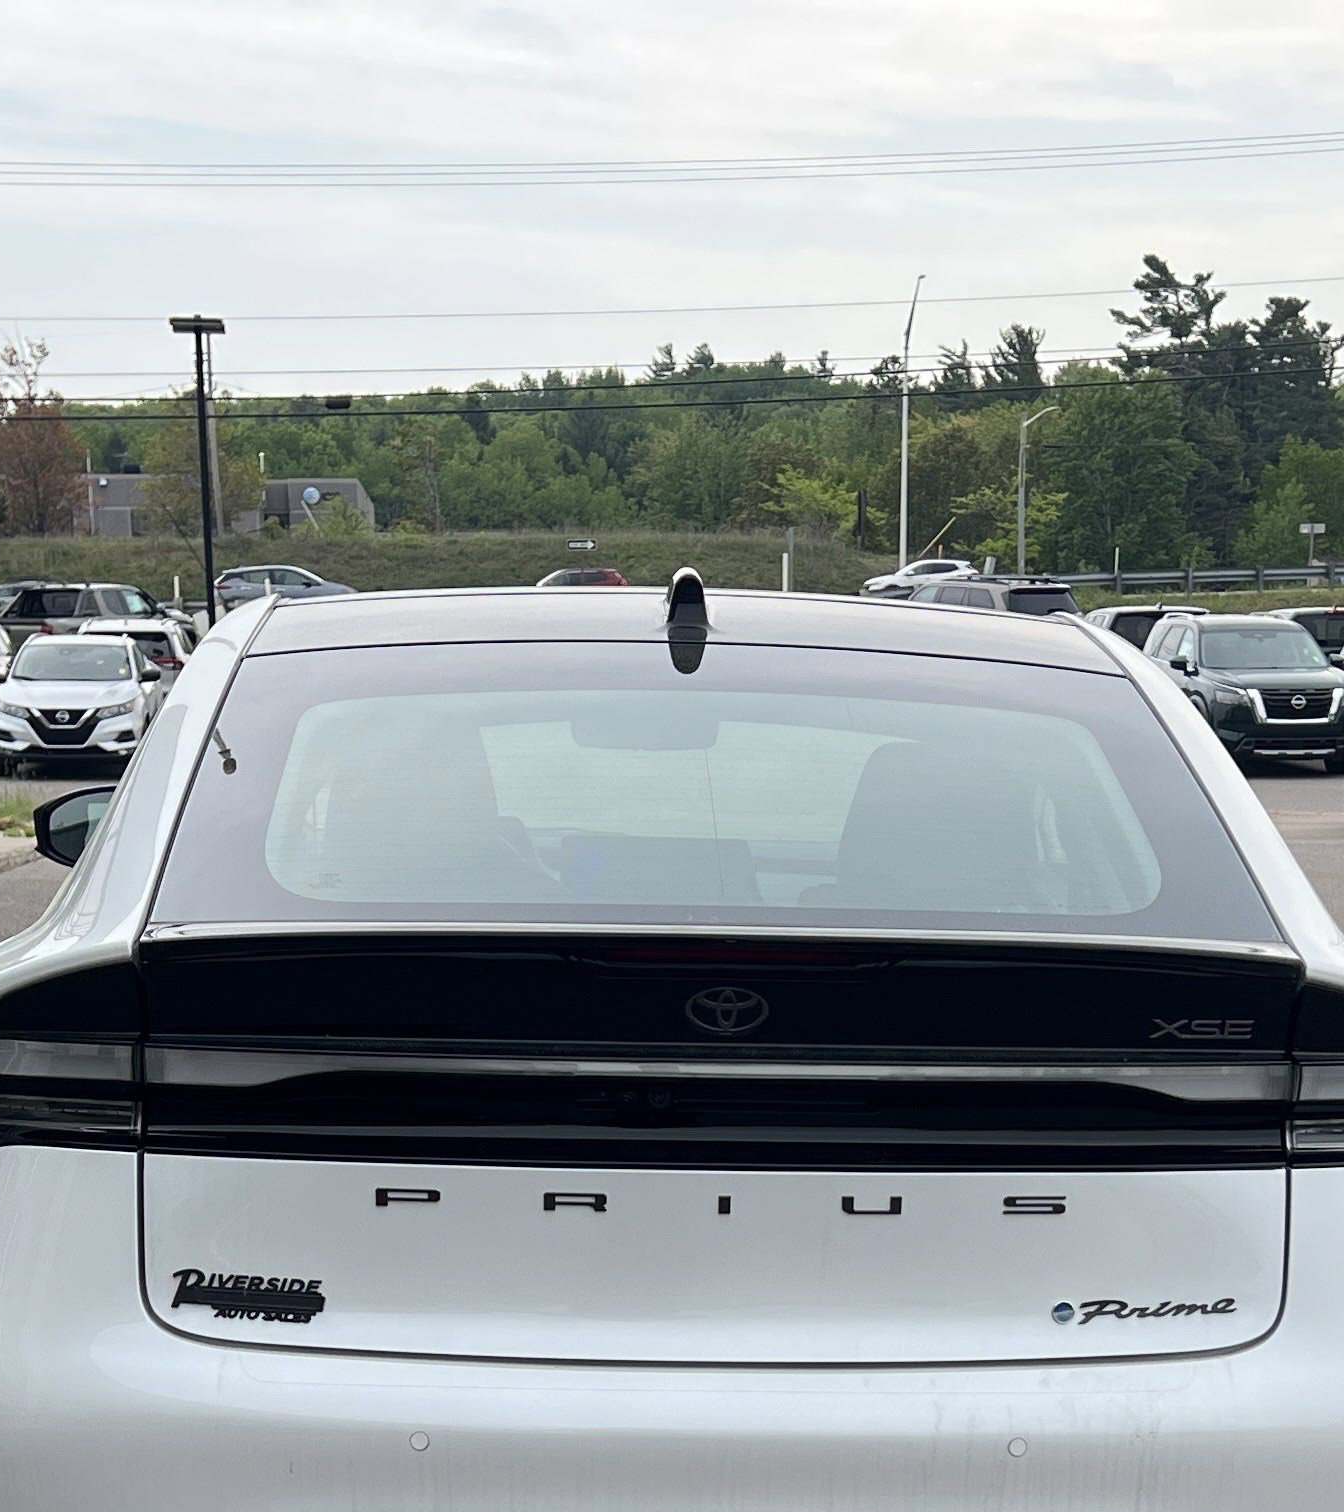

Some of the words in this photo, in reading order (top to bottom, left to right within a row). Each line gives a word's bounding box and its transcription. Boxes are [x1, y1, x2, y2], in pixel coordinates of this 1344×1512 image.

[1149, 1018, 1255, 1040] XSE
[375, 1187, 1067, 1216] PRIUS
[171, 1268, 323, 1308] RIVERSIDE
[1077, 1297, 1238, 1326] Prime
